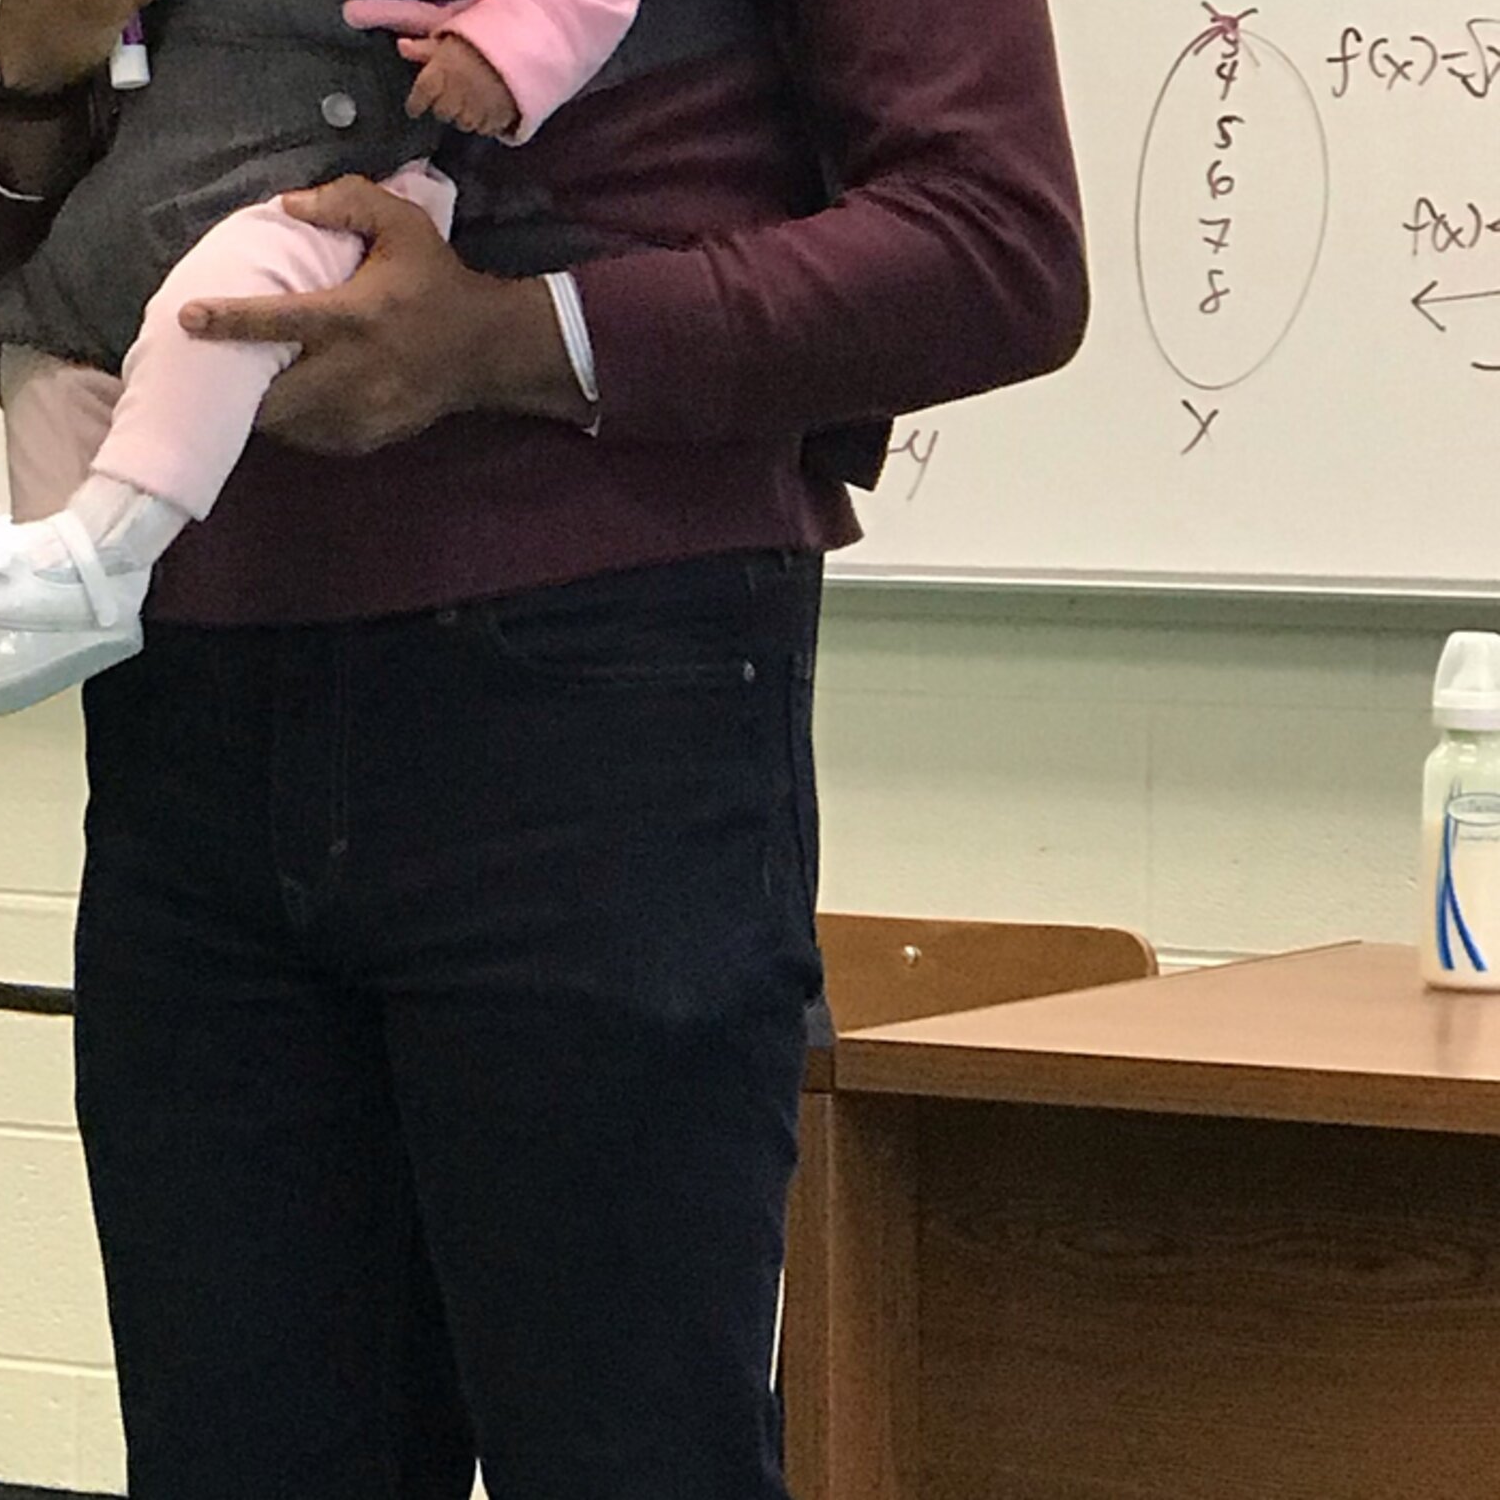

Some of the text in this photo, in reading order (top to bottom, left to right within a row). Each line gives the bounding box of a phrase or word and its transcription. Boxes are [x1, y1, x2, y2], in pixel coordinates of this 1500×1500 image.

[1213, 113, 1246, 151] 5
[1205, 158, 1236, 200] 6
[1198, 217, 1233, 255] 7
